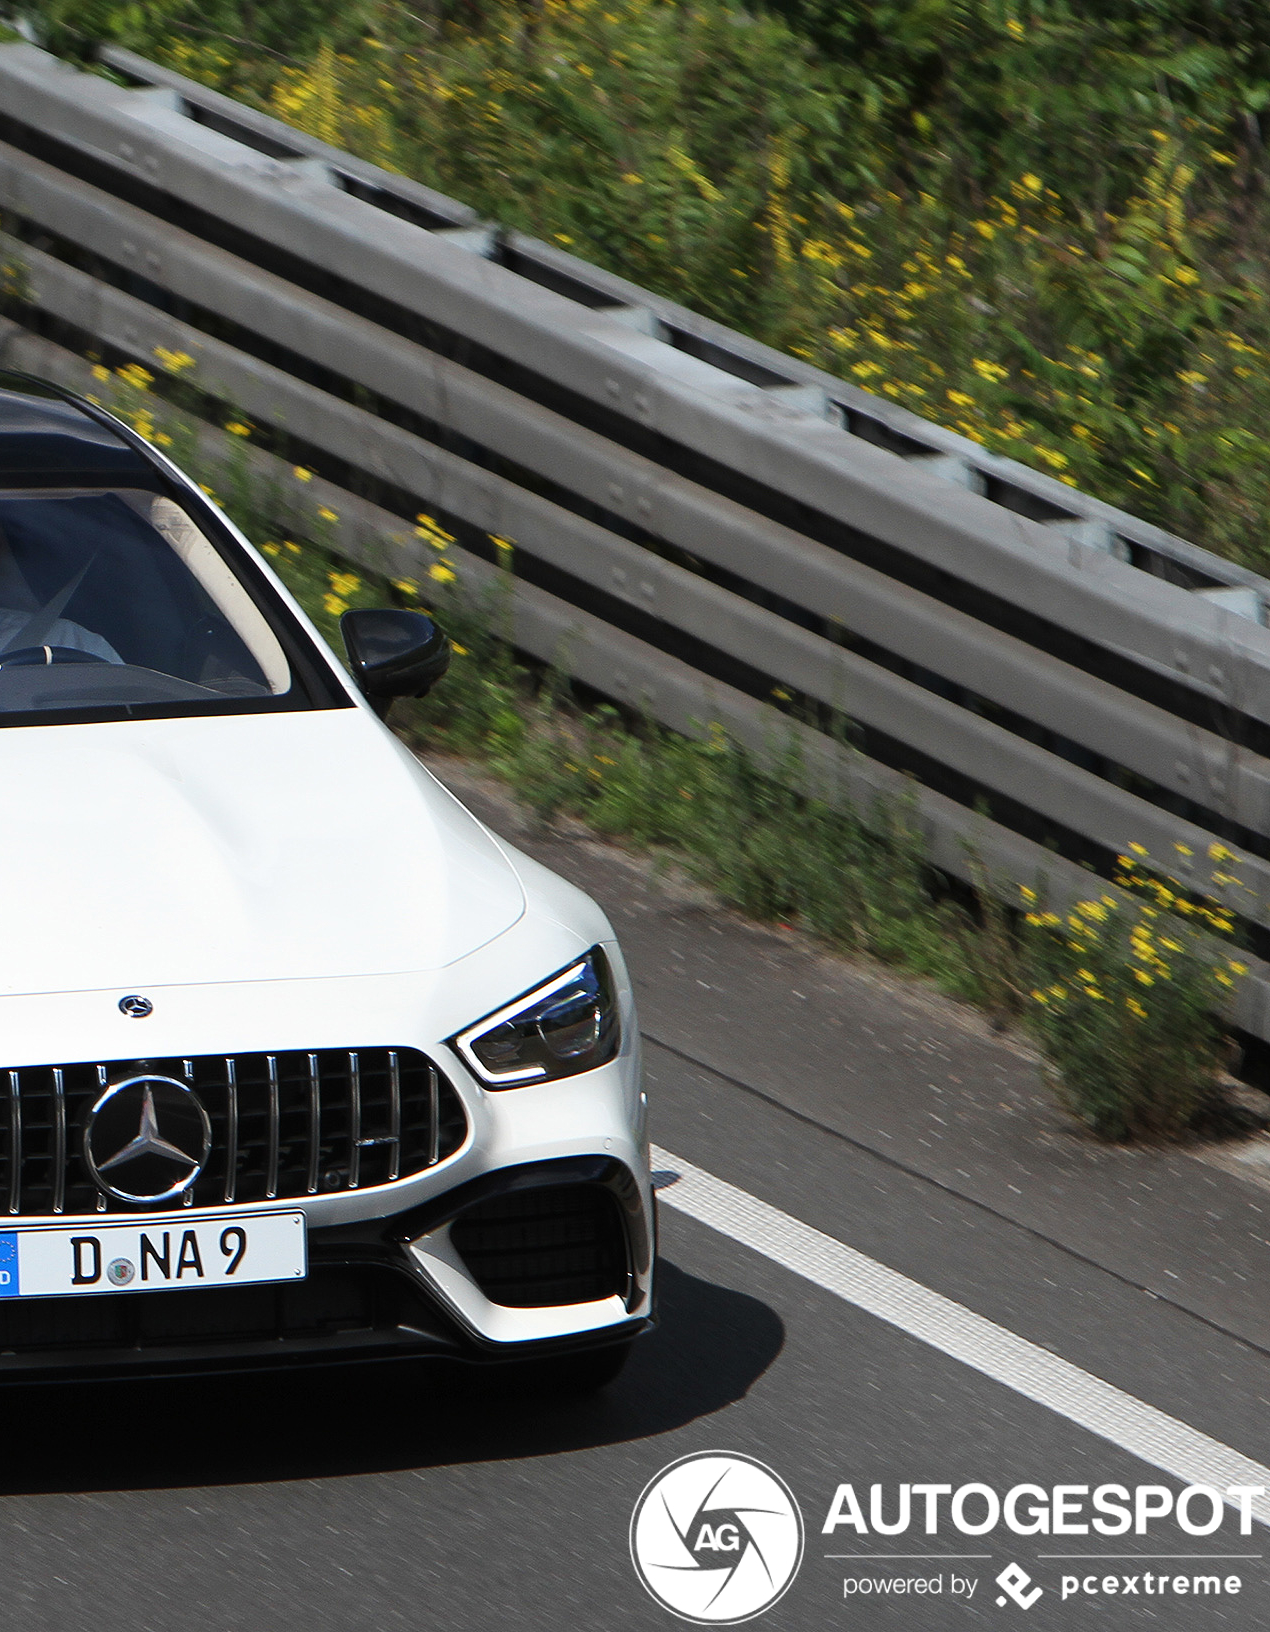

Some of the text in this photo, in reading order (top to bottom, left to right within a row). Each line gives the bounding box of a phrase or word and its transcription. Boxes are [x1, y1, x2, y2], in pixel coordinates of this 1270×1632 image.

[71, 1226, 247, 1285] D NA 9
